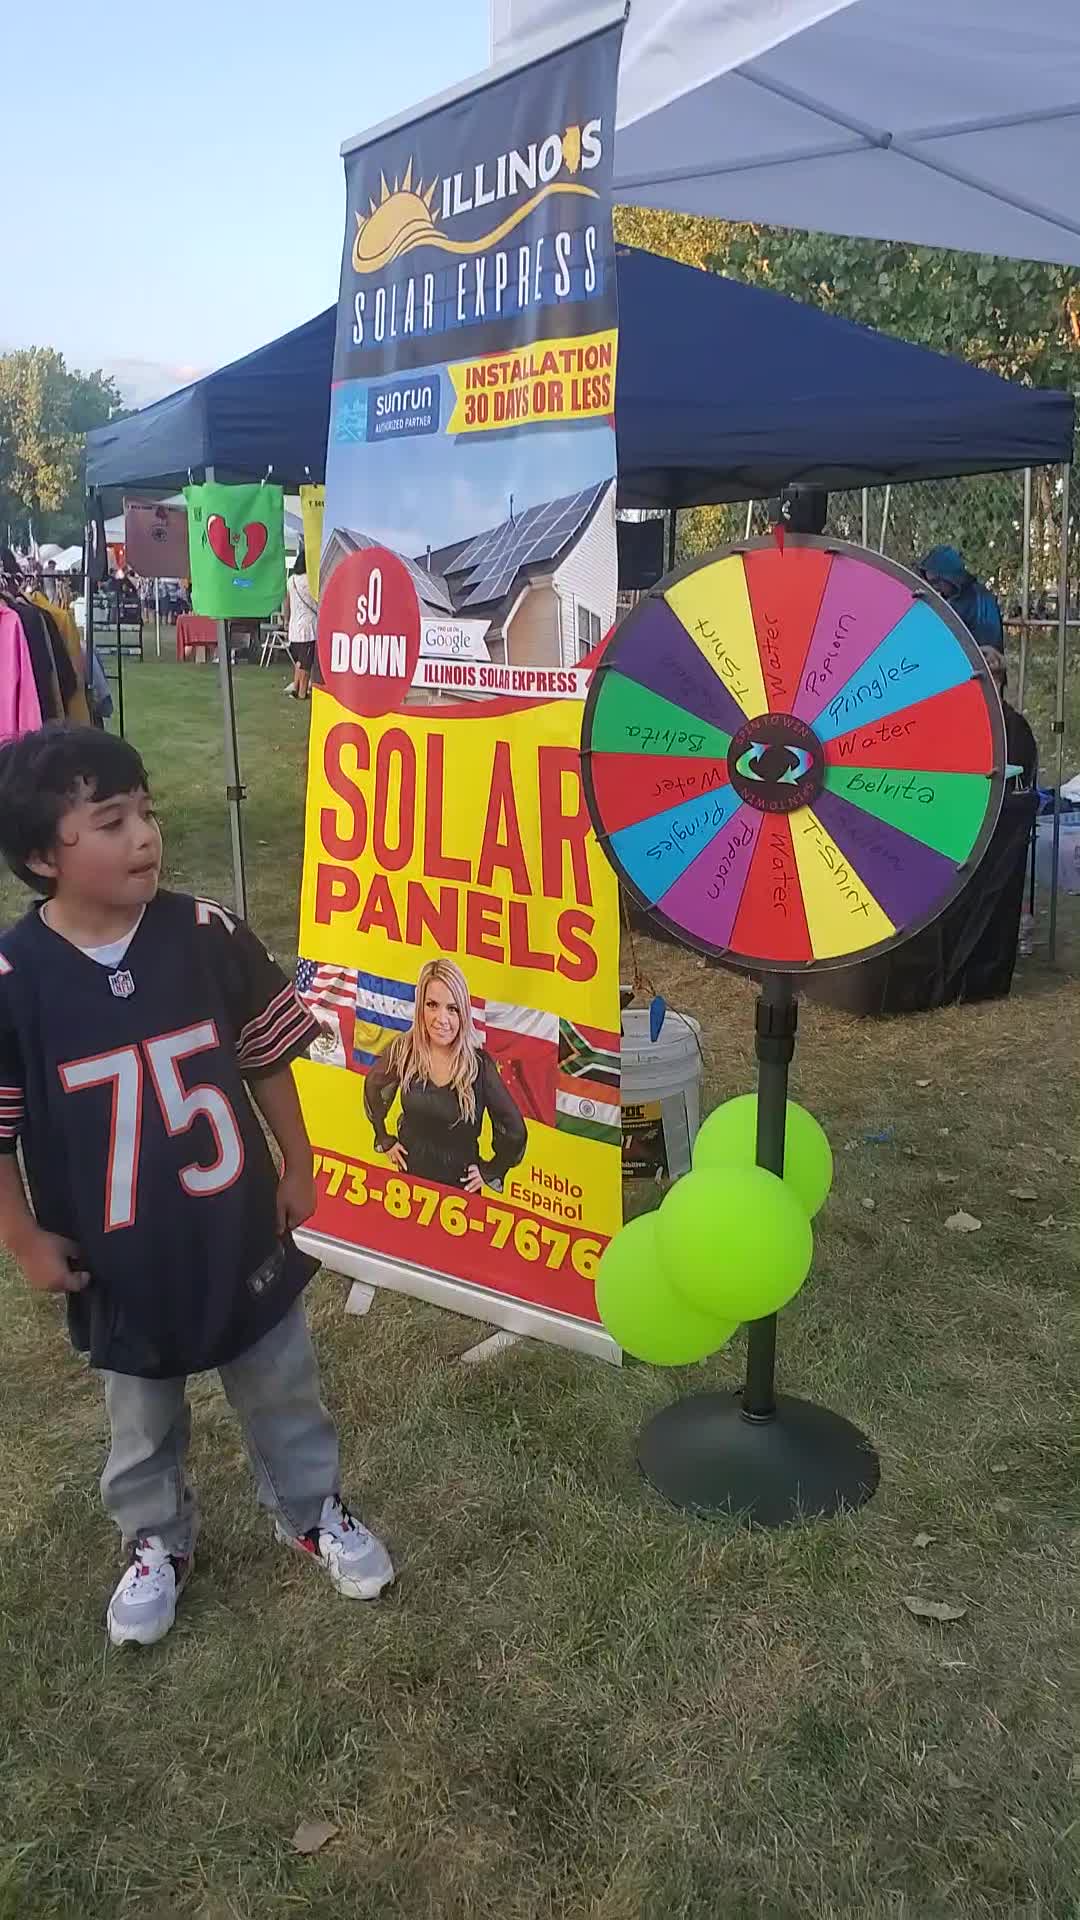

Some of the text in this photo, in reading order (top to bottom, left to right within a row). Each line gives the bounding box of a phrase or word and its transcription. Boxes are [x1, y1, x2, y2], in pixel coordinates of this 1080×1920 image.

[353, 225, 597, 345] SOLAR EXPRESS
[465, 342, 612, 390] INSTALLATION
[376, 386, 432, 416] sunrun
[404, 415, 432, 429] PARTNER
[464, 373, 611, 425] 30 DAYS OR LESS
[330, 631, 407, 678] DOWN
[425, 628, 471, 653] Google
[762, 613, 787, 697] Water
[424, 663, 578, 693] ILLINOIS SOLAR EXPRESS
[828, 656, 920, 727] Pringles
[838, 720, 916, 758] Water
[652, 767, 721, 797] Water
[846, 773, 935, 804] Belvita
[319, 721, 594, 907] SOLAR
[646, 800, 725, 860] Pringles
[769, 832, 795, 917] Water
[314, 862, 599, 983] PANELS
[57, 1018, 245, 1234] 75
[510, 1182, 583, 1222] Español
[530, 1165, 583, 1199] Hablo
